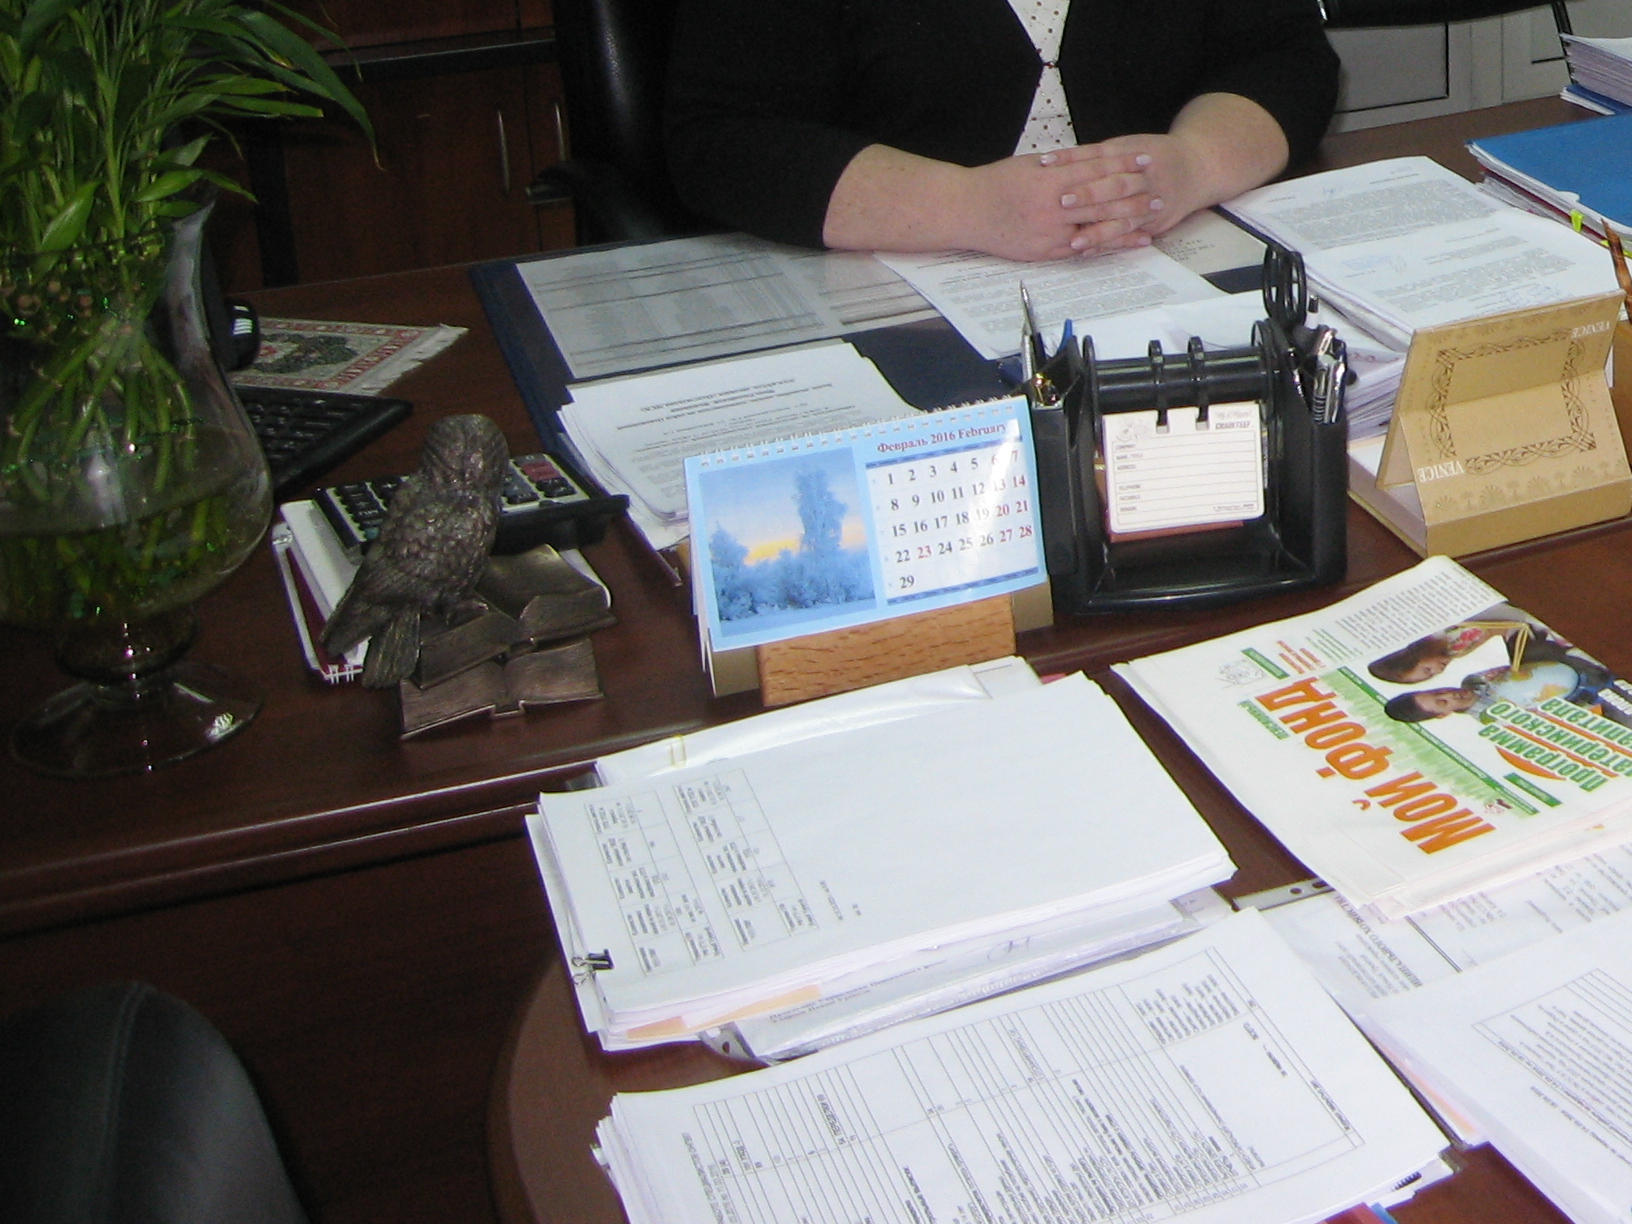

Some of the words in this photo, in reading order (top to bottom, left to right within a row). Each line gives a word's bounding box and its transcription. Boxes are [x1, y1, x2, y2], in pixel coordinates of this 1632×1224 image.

[877, 436, 928, 453] Февраль
[931, 432, 956, 445] 2016
[958, 422, 1006, 439] February
[887, 473, 894, 485] 1
[908, 469, 917, 481] 2
[929, 465, 937, 478] 3
[950, 461, 958, 473] 4
[971, 457, 979, 470] 5
[1011, 450, 1019, 462] 7
[1417, 461, 1464, 482] VENICE
[891, 498, 900, 511] 8
[912, 494, 920, 507] 9
[930, 490, 945, 504] 10
[952, 487, 964, 500] 11
[972, 482, 985, 496] 12
[1012, 475, 1026, 488] 14
[892, 524, 907, 537] 15
[914, 520, 928, 533] 16
[934, 516, 949, 529] 17
[955, 512, 969, 525] 18
[976, 508, 990, 521] 19
[996, 504, 1010, 517] 20
[1016, 500, 1029, 513] 21
[895, 550, 911, 563] 22
[917, 546, 932, 559] 23
[938, 542, 953, 555] 24
[959, 537, 974, 551] 25
[979, 533, 994, 547] 26
[999, 529, 1013, 542] 27
[1019, 525, 1032, 538] 28
[900, 576, 915, 589] 29
[1352, 770, 1496, 854] Мой
